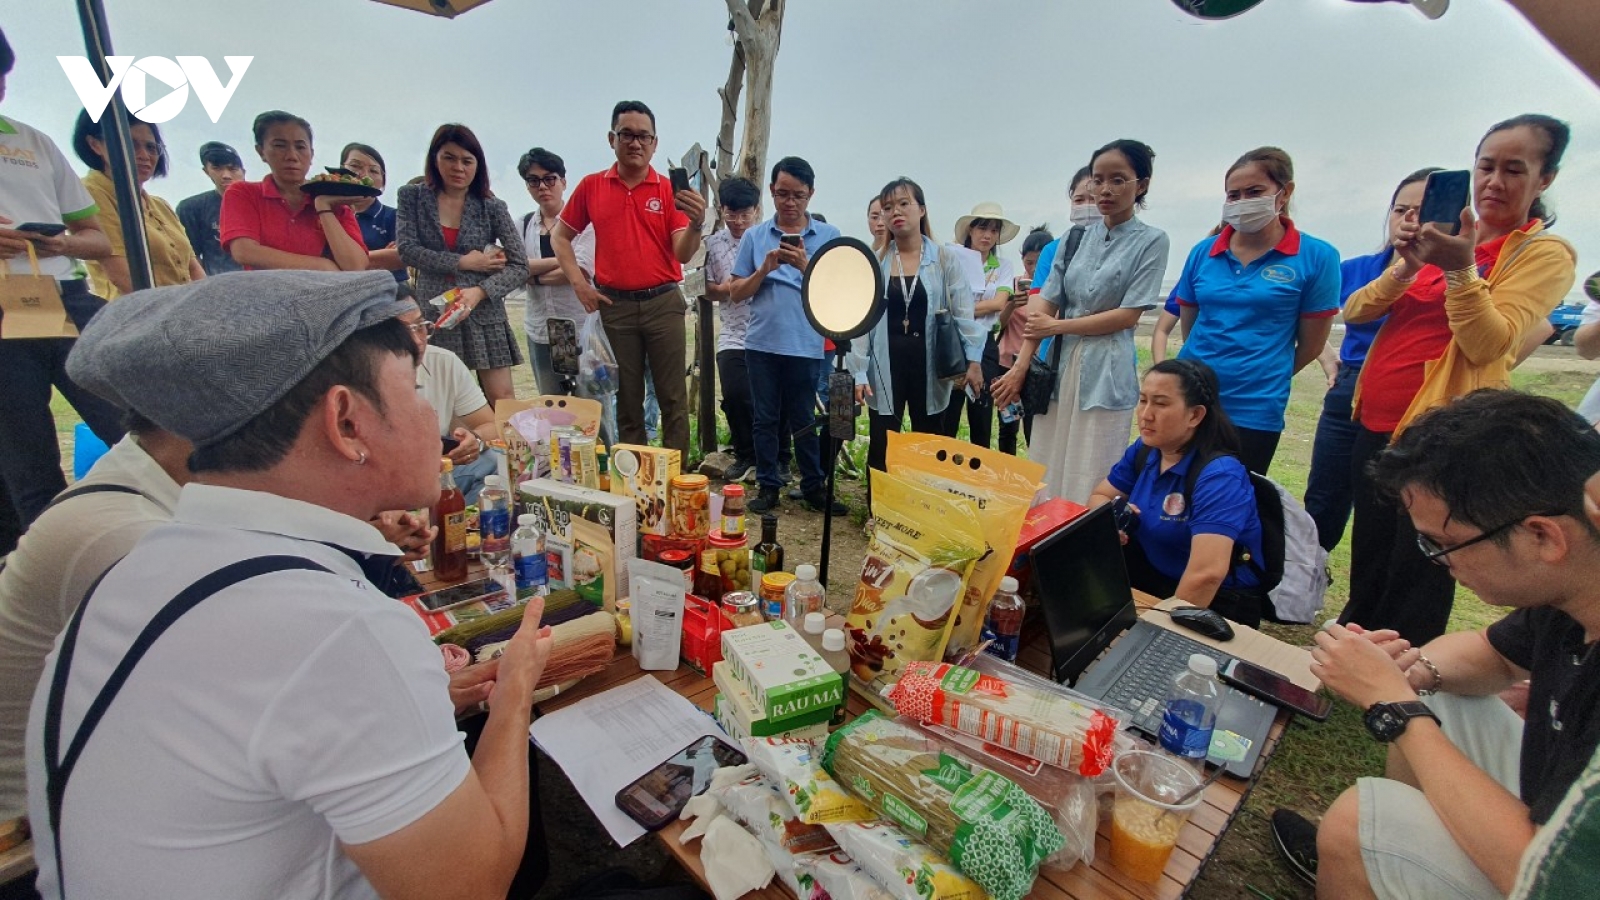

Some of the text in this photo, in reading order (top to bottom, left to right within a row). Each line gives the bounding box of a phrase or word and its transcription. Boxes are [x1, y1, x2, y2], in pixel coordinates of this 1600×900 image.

[893, 522, 922, 540] MORE
[773, 695, 809, 718] RAU
[813, 684, 841, 707] MÁ
